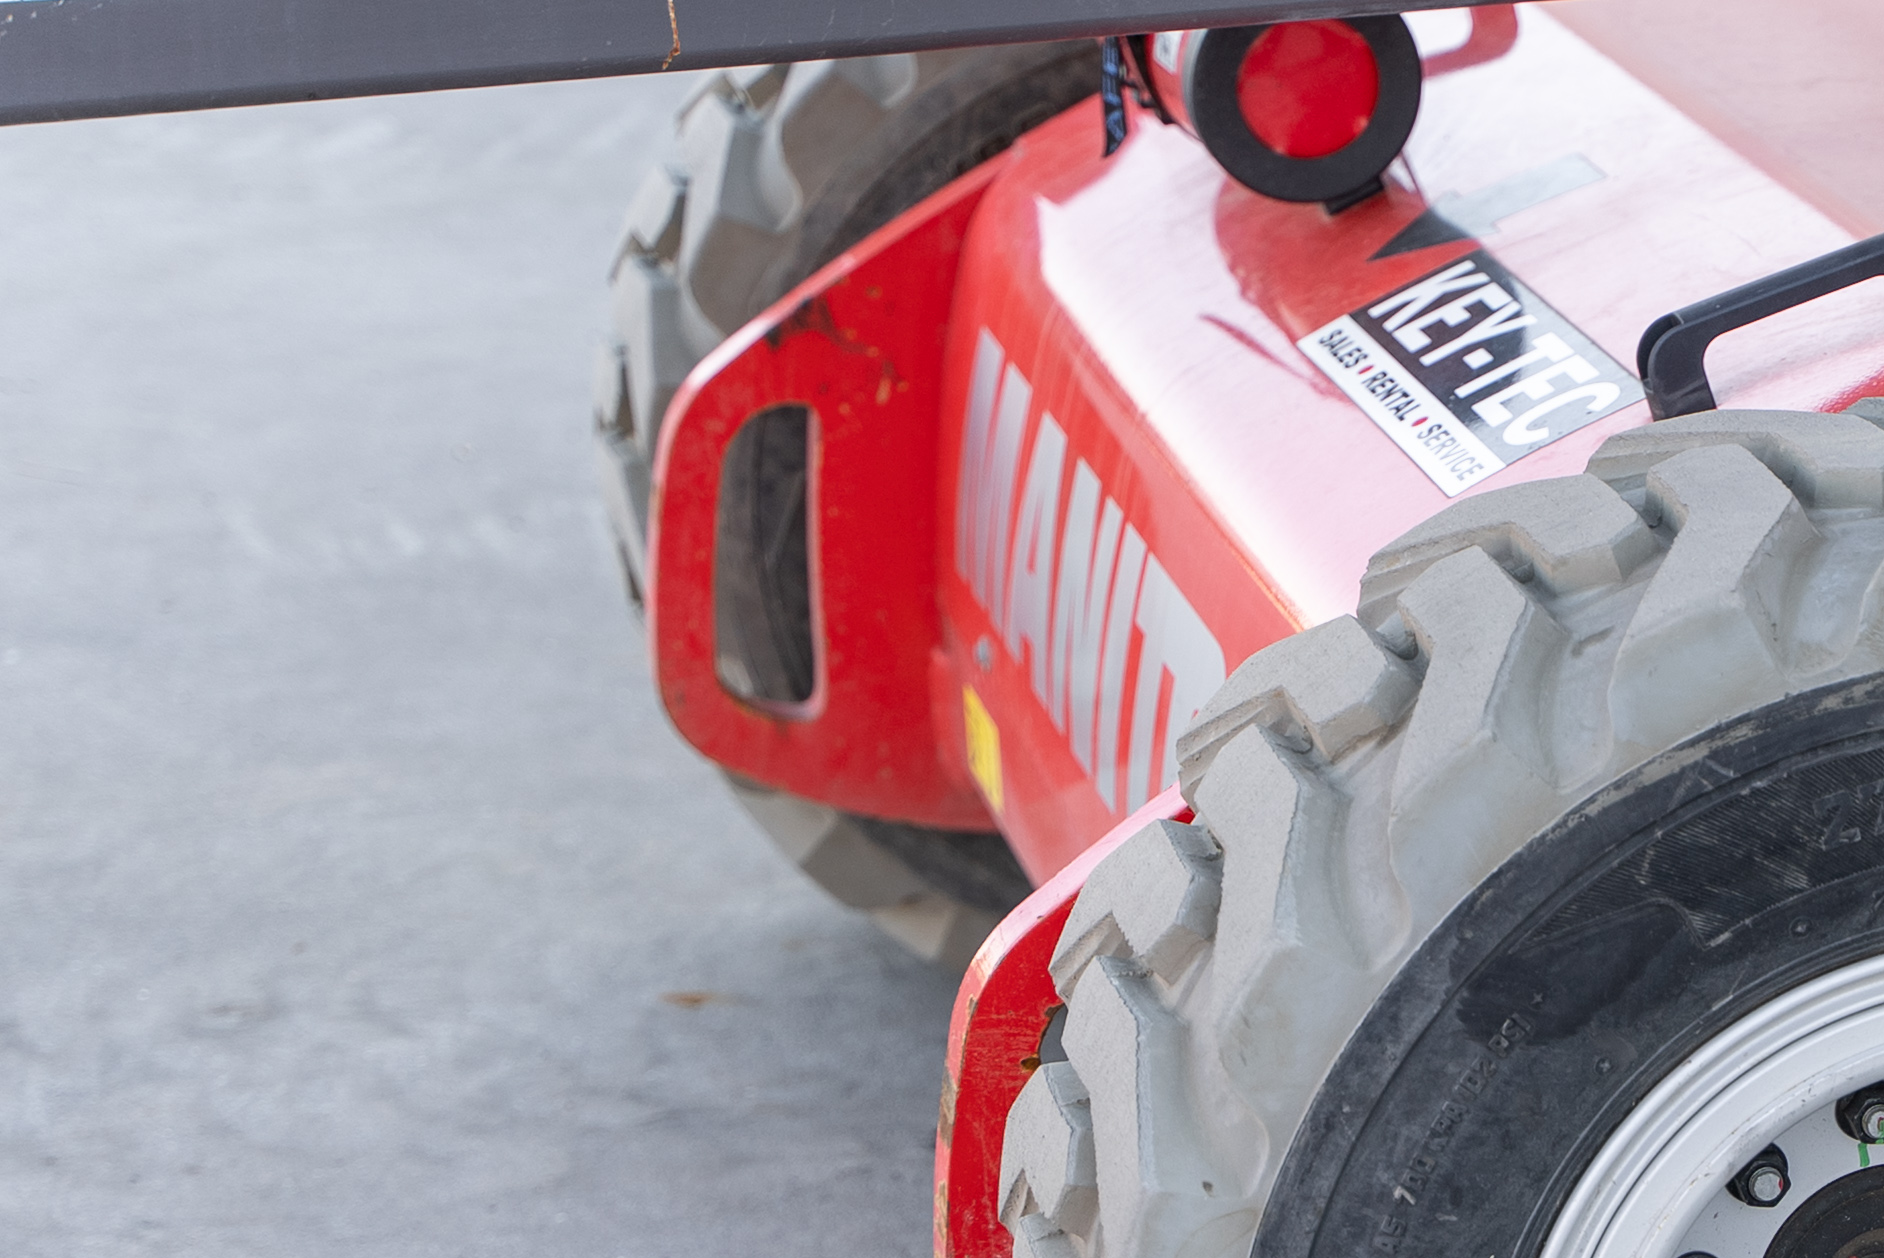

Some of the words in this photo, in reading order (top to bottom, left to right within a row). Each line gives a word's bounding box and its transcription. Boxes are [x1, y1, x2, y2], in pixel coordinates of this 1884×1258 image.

[1317, 328, 1367, 369] SALES
[1360, 371, 1421, 423] RENTAL
[1417, 423, 1486, 483] SERVICE
[1367, 259, 1621, 446] KEY-TEC
